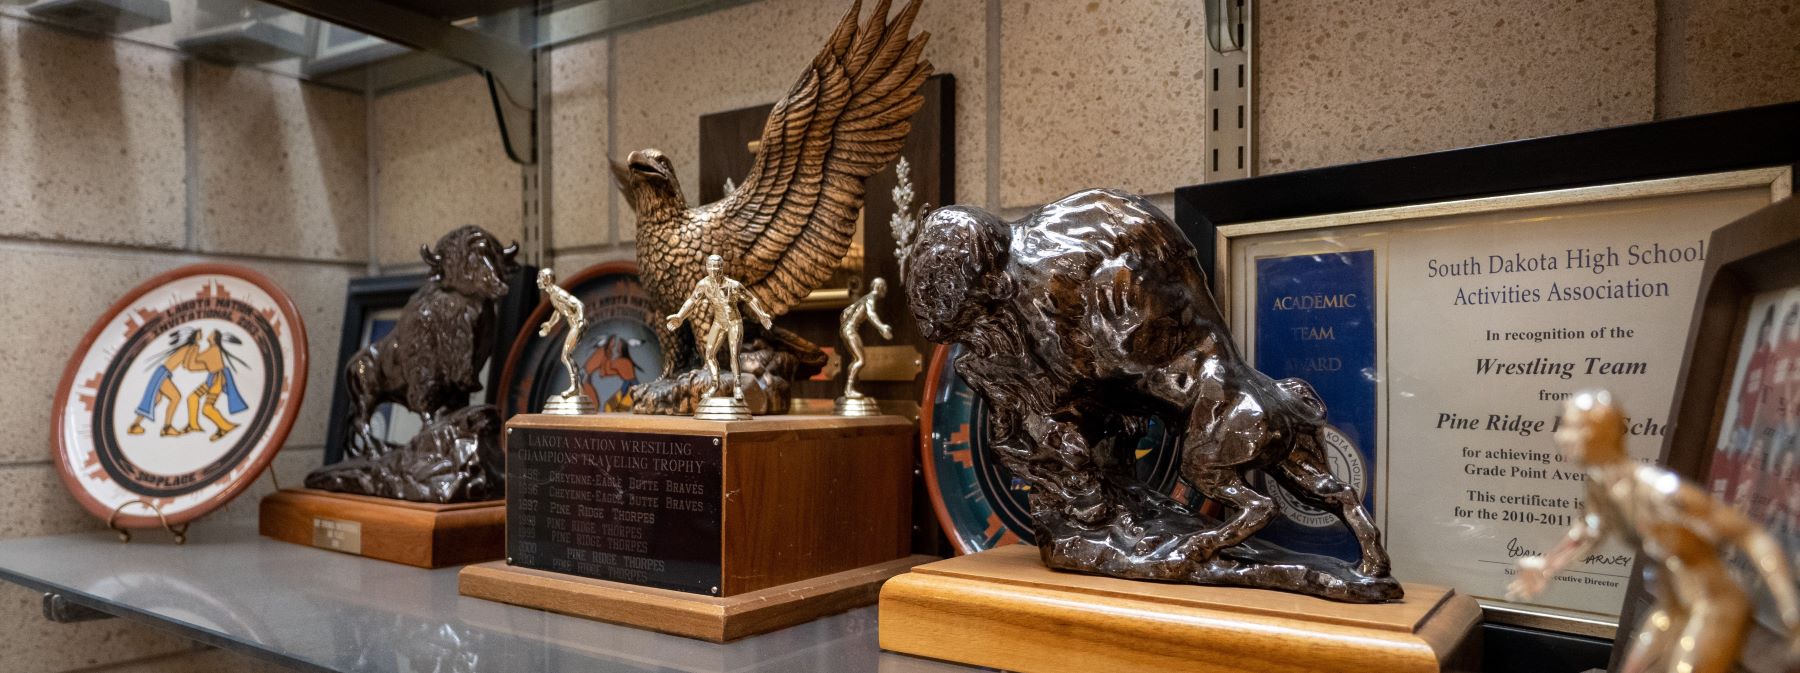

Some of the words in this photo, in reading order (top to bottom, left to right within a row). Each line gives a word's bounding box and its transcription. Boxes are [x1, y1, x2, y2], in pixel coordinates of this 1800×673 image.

[1428, 256, 1481, 278] South
[1488, 253, 1558, 274] Dakota
[1565, 247, 1619, 274] High
[1628, 240, 1705, 266] School
[1453, 285, 1541, 306] Activities
[1546, 278, 1670, 302] Association
[1272, 294, 1356, 311] ACADEMIC
[1291, 327, 1336, 340] TEAM
[1486, 329, 1500, 341] In
[1505, 327, 1585, 343] recognition
[1590, 327, 1605, 339] of
[1609, 326, 1634, 338] the
[1475, 357, 1576, 380] Wrestling
[1584, 357, 1648, 375] Team
[1436, 413, 1479, 430] Pine
[1485, 414, 1545, 437] Ridge
[528, 434, 569, 449] LAKOTA
[574, 437, 615, 451] NATION
[620, 440, 692, 456] WRESTLING
[1327, 432, 1349, 452] KOTA
[518, 448, 578, 464] CHAMPIONS
[582, 453, 648, 470] TRAVELING
[652, 458, 705, 474] TROPHY
[1462, 447, 1481, 458] for
[1485, 449, 1550, 464] achieving
[1464, 464, 1506, 477] Grade
[1511, 466, 1547, 479] Point
[1552, 470, 1587, 482] Aver
[629, 477, 659, 491] BUTTE
[665, 480, 704, 495] BRAVES
[628, 493, 659, 508] BUTTE
[665, 496, 704, 512] BRAVES
[1466, 490, 1496, 503] This
[1499, 493, 1569, 508] certificate
[550, 502, 571, 515] PINE
[577, 504, 604, 519] RIDGE
[612, 507, 655, 524] THORPES
[1289, 512, 1335, 525] ACTIVITIES
[1454, 506, 1474, 518] for
[1477, 509, 1498, 520] the
[1502, 510, 1571, 526] 2010-2011
[546, 517, 566, 530] PINE
[571, 520, 596, 534] RIDGE
[602, 523, 642, 539] THORPES
[551, 530, 571, 543] PINE
[576, 533, 601, 548] RIDGE
[607, 537, 648, 553] THORPES
[567, 547, 587, 561] PINE
[592, 551, 617, 566] RIDGE
[624, 556, 664, 572] THORPES
[552, 559, 572, 571] PINE
[608, 566, 648, 583] THORPES
[1584, 576, 1619, 588] Director
